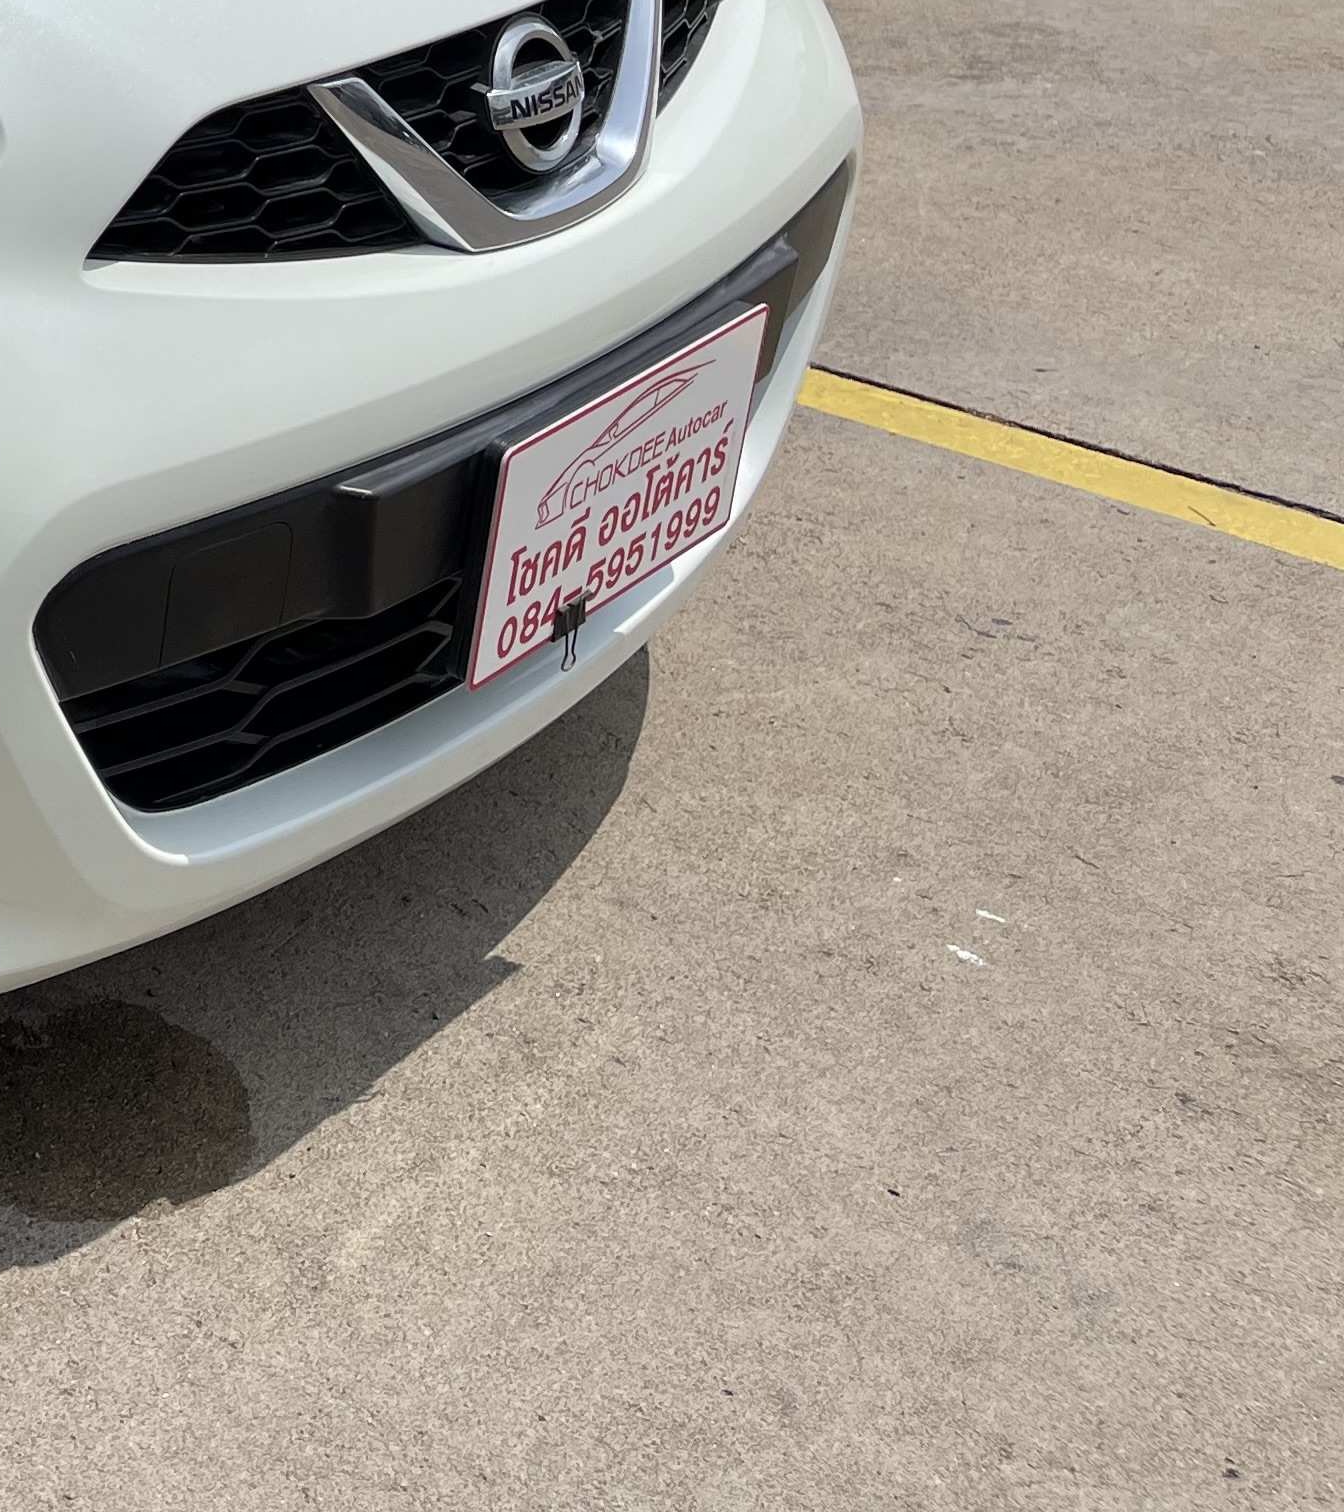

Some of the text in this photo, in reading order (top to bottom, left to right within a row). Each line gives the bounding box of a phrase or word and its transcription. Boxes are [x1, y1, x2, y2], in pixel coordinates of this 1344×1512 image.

[510, 74, 583, 120] NISSAN
[507, 418, 734, 606] โชคดี ออโต้คาร์
[570, 400, 728, 509] CHOKDEE Autocar
[497, 486, 721, 659] 084-5951999
